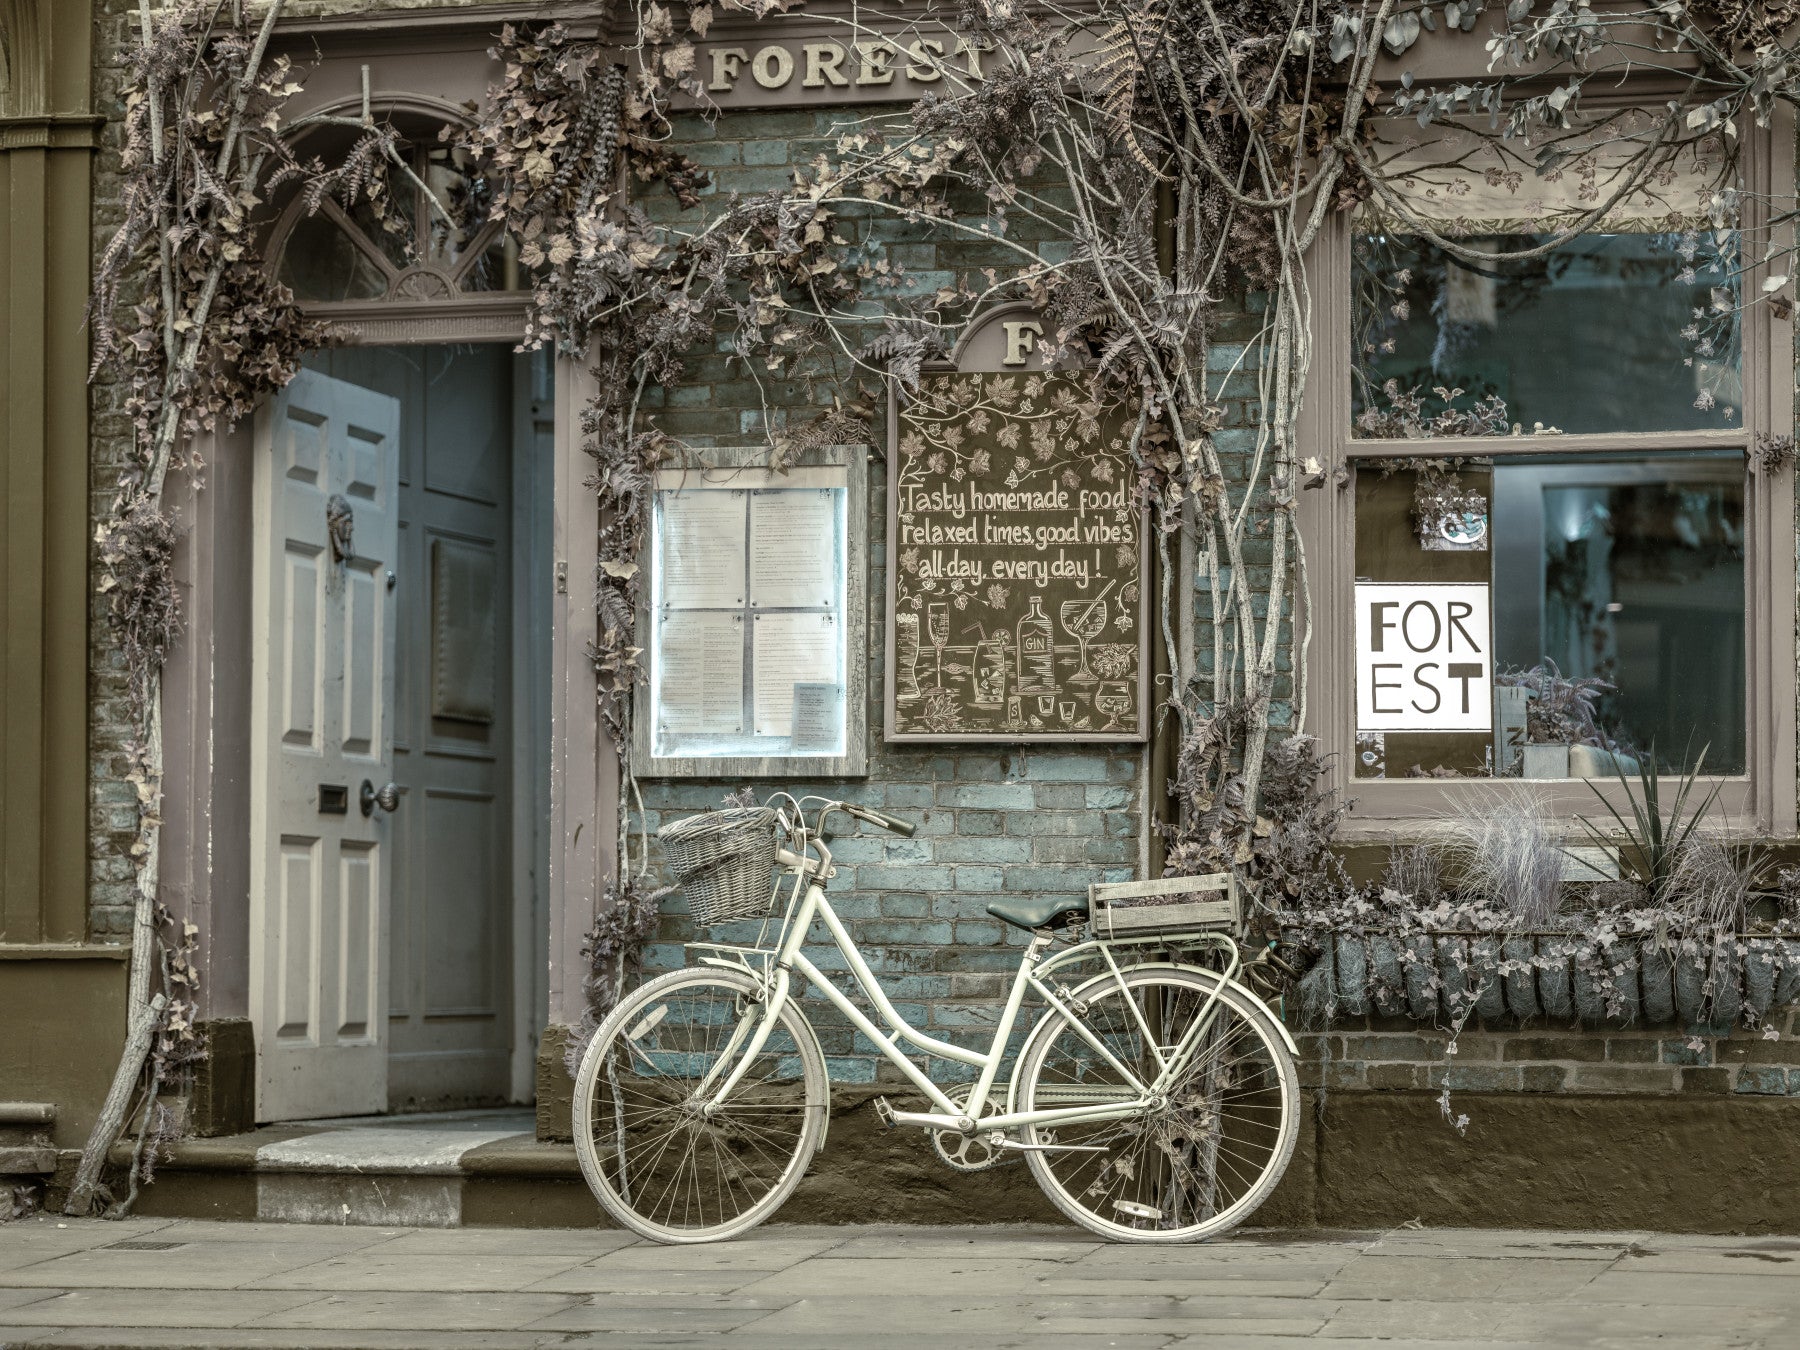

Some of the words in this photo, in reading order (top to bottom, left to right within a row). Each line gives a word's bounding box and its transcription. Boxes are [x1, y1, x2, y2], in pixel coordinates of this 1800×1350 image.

[707, 37, 995, 92] FOREST
[1001, 321, 1043, 366] F
[900, 482, 965, 519] Tasty
[970, 480, 1069, 512] homemade
[1080, 479, 1127, 518] food
[902, 517, 977, 544] relaxed
[1035, 516, 1080, 550] good
[1084, 516, 1134, 543] vibes
[992, 560, 1048, 588] every
[1025, 637, 1046, 650] GIN
[1370, 600, 1481, 653] FOR
[1371, 662, 1483, 714] EST
